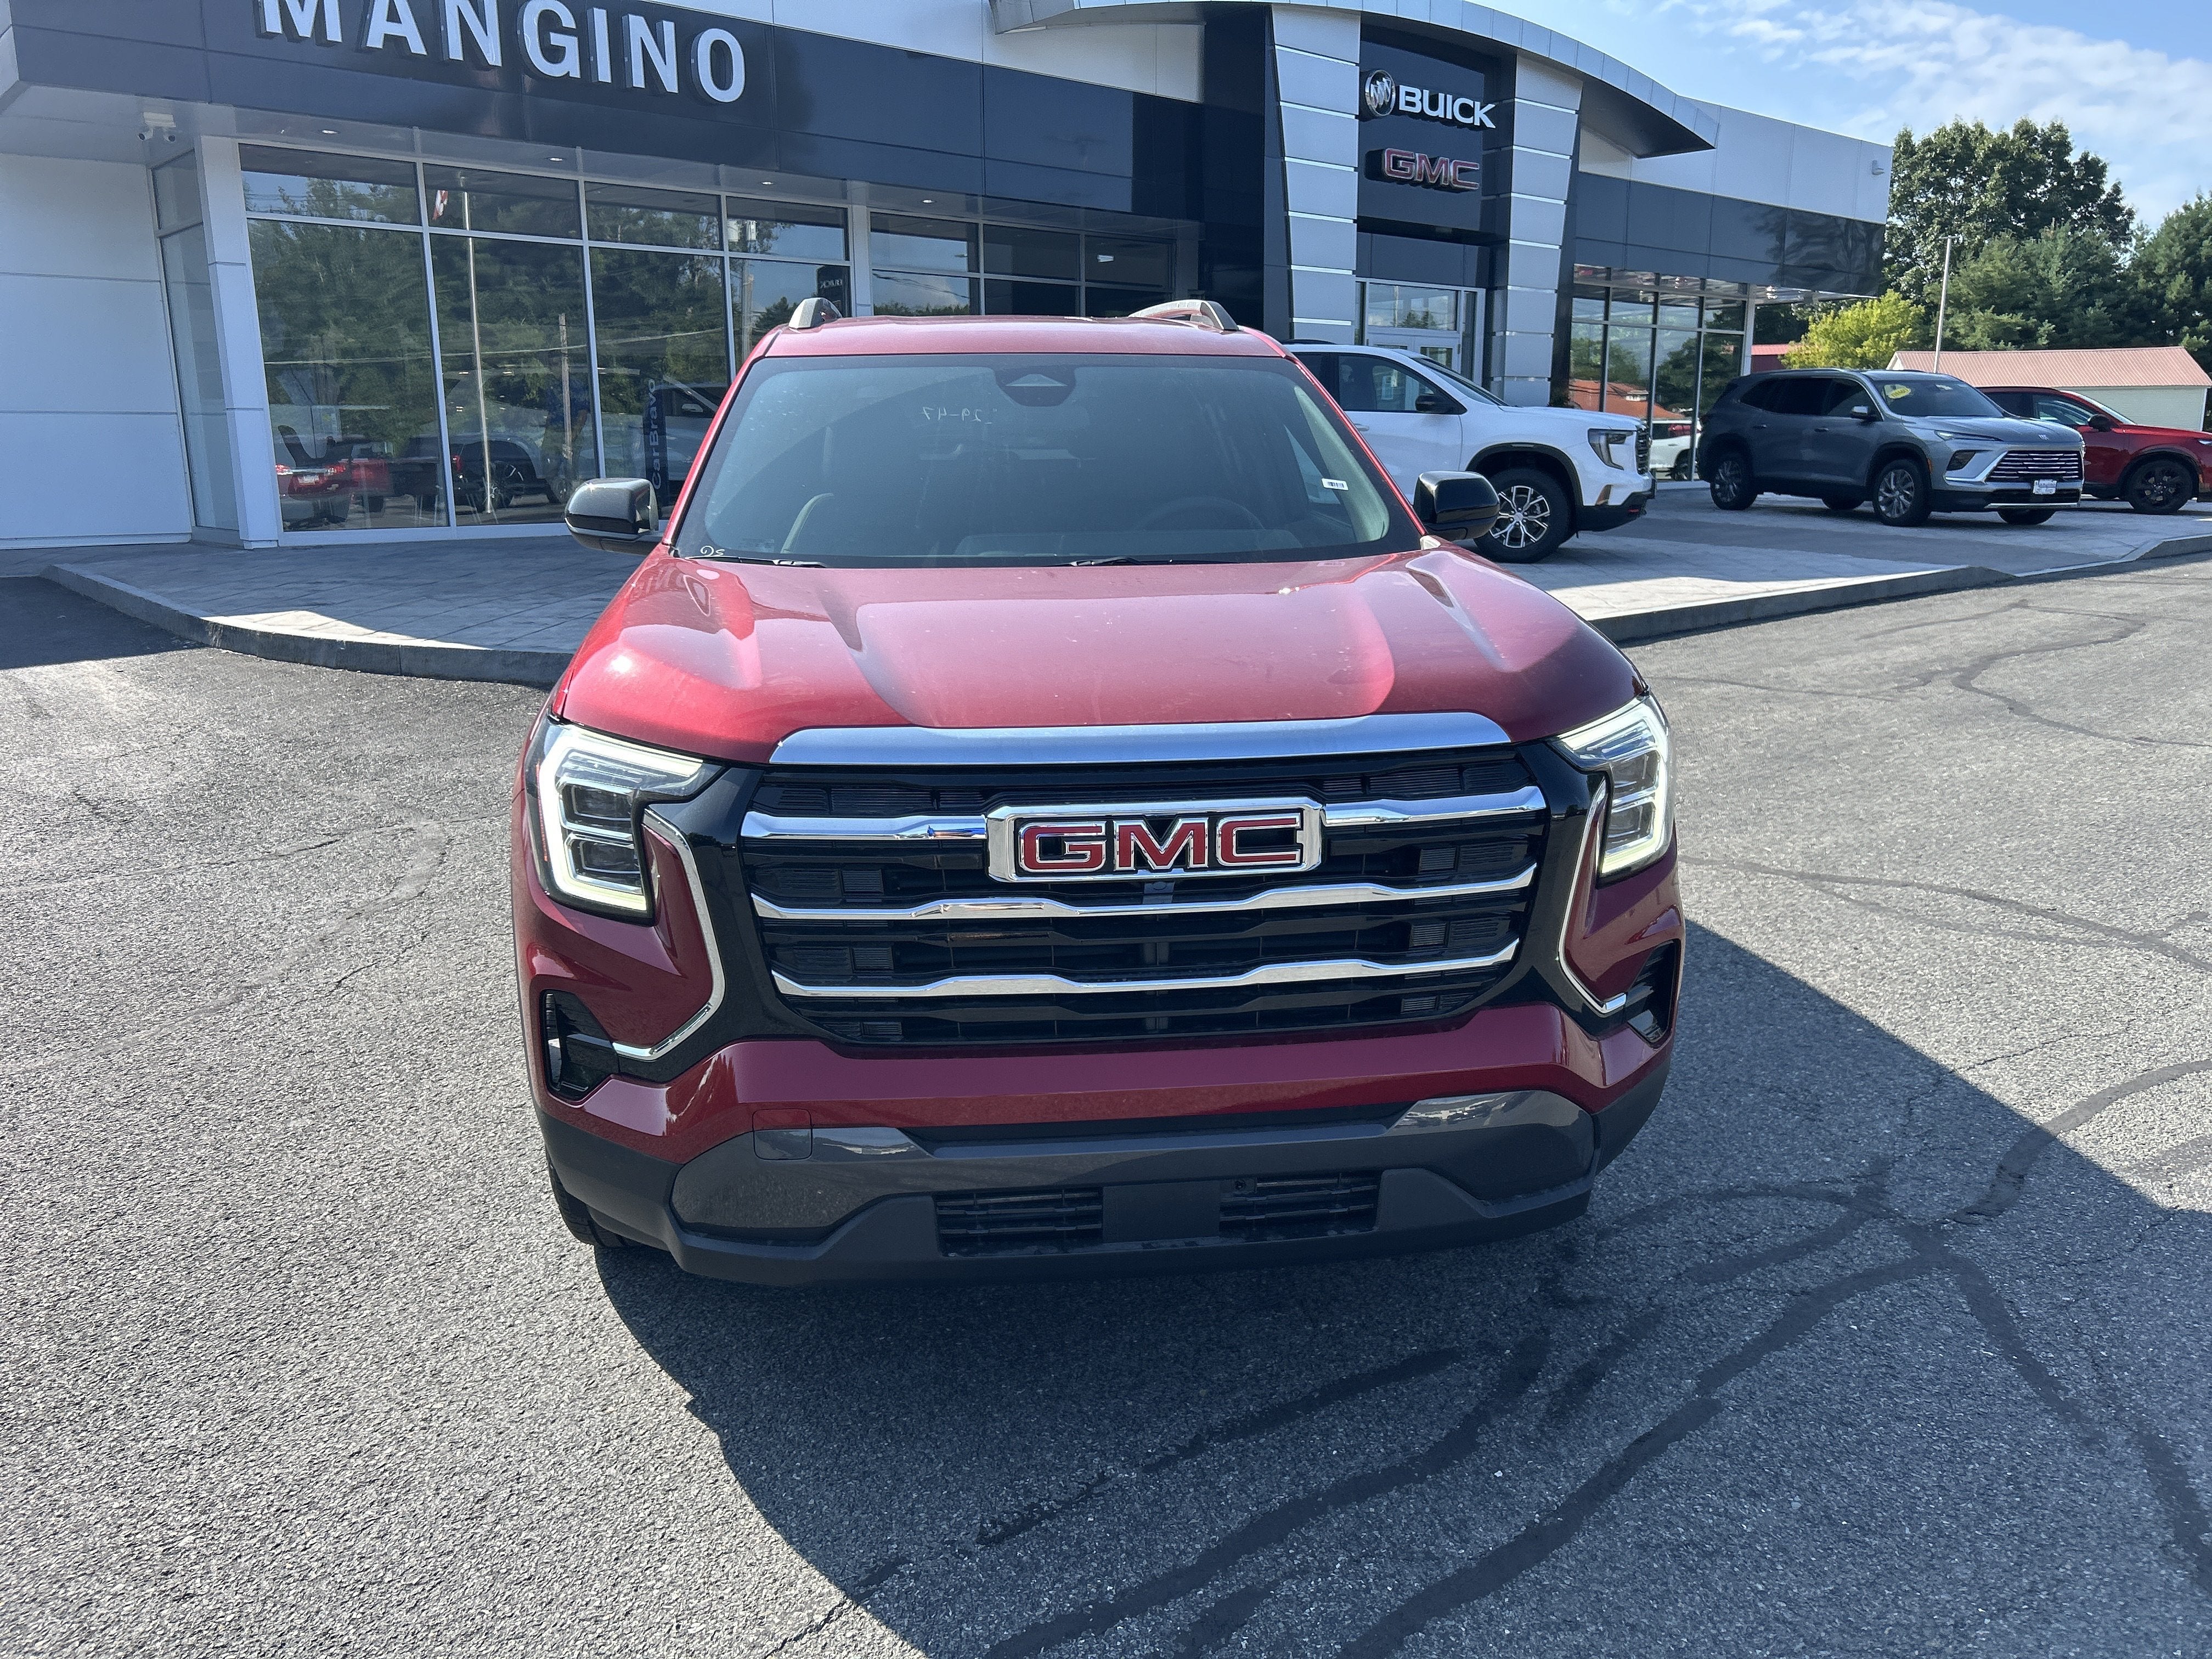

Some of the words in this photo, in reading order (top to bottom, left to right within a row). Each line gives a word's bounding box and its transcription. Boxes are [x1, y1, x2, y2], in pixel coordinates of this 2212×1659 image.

[261, 0, 746, 103] MANGINO
[1398, 85, 1496, 129] BUICK
[1383, 148, 1480, 190] GMC
[648, 379, 662, 490] CarBravo
[1018, 812, 1302, 872] GMC
